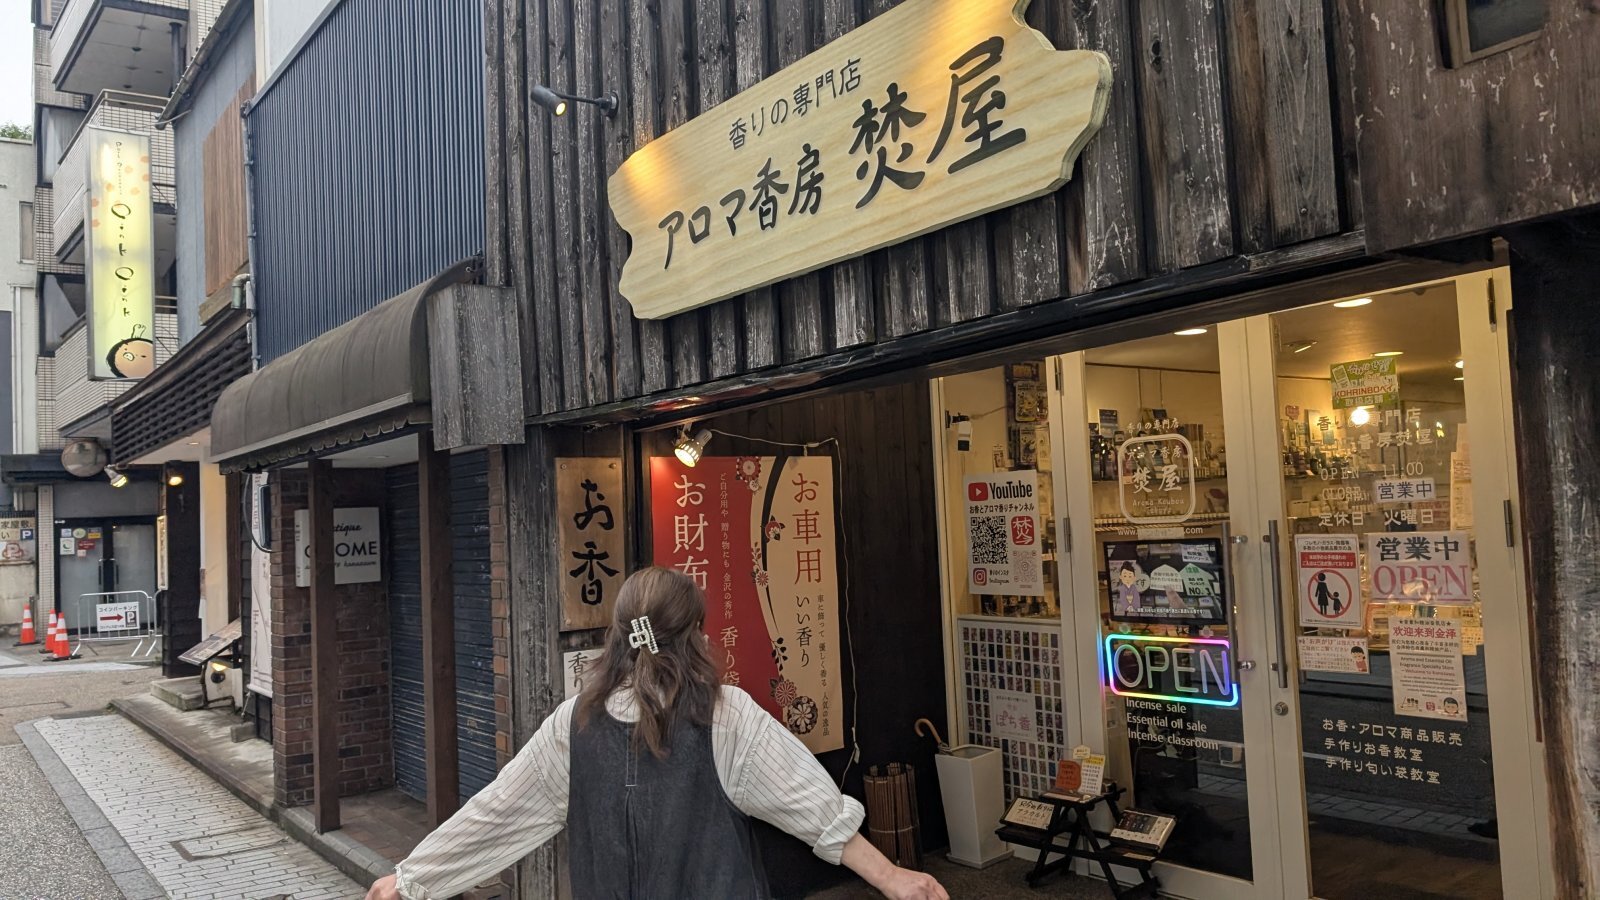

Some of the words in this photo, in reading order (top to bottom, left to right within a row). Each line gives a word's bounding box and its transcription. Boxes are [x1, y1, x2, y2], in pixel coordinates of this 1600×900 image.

[728, 58, 863, 151] 香りの専門店
[658, 144, 826, 270] アロマ香房
[848, 36, 1028, 210] 焚屋
[1132, 464, 1183, 494] 焚屋
[1320, 467, 1361, 481] OPEN
[1382, 462, 1424, 478] 11:00
[719, 473, 730, 517] ご自分用や
[989, 480, 1033, 500] YouTube
[1377, 480, 1433, 500] 営業中
[791, 472, 823, 585] お車用
[1318, 510, 1364, 527] 定休日
[1384, 509, 1435, 526] 火曜日
[569, 478, 620, 606] お香
[672, 474, 709, 592] お財布
[1376, 535, 1460, 562] 営業中
[1373, 564, 1469, 597] OPEN
[722, 573, 734, 619] 金沢の秀作
[795, 594, 813, 668] いい香り
[1393, 626, 1457, 639] 欢迎来到金泽
[720, 626, 740, 686] 香り袋
[1113, 643, 1231, 696] OPEN
[1126, 697, 1162, 711] Incense
[1166, 703, 1187, 714] sale
[1126, 713, 1168, 728] Essential
[1170, 718, 1184, 730] oil
[1186, 720, 1207, 733] sale
[1322, 718, 1463, 747] お香・アロマ商品販売
[1127, 728, 1164, 743] Incense
[1167, 733, 1219, 751] classroom
[1324, 737, 1424, 762] 手作りお香教室
[1325, 756, 1441, 785] 手作り匂い袋教室
